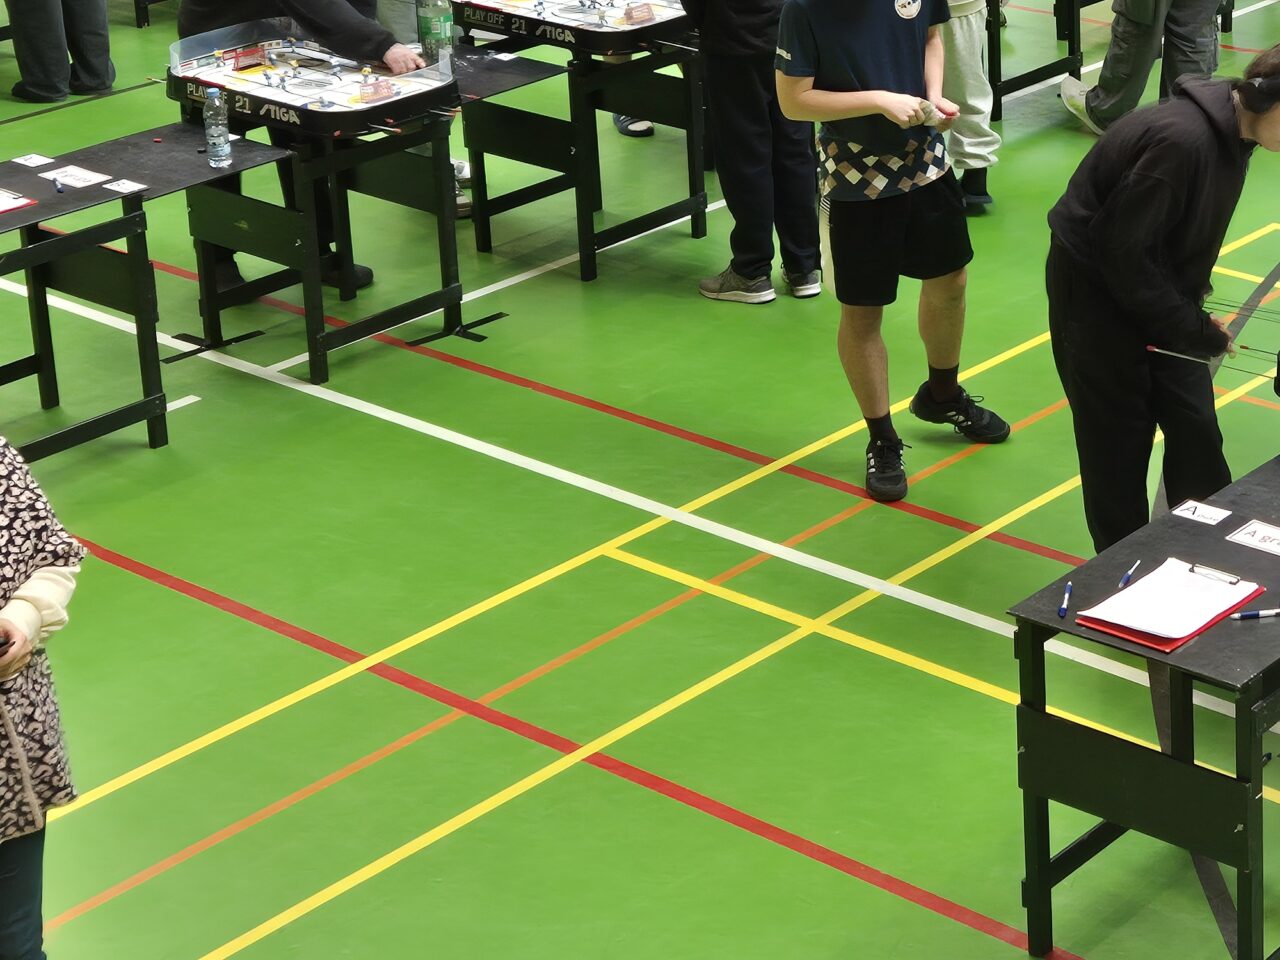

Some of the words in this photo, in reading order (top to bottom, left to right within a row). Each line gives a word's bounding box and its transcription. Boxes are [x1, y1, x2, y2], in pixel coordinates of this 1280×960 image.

[464, 7, 485, 22] PLAY
[487, 12, 505, 25] OFF
[511, 18, 527, 35] 21
[535, 24, 577, 43] STIGA
[235, 95, 252, 114] 21
[259, 103, 301, 125] STIGA
[1180, 505, 1198, 516] A
[1243, 529, 1258, 538] A
